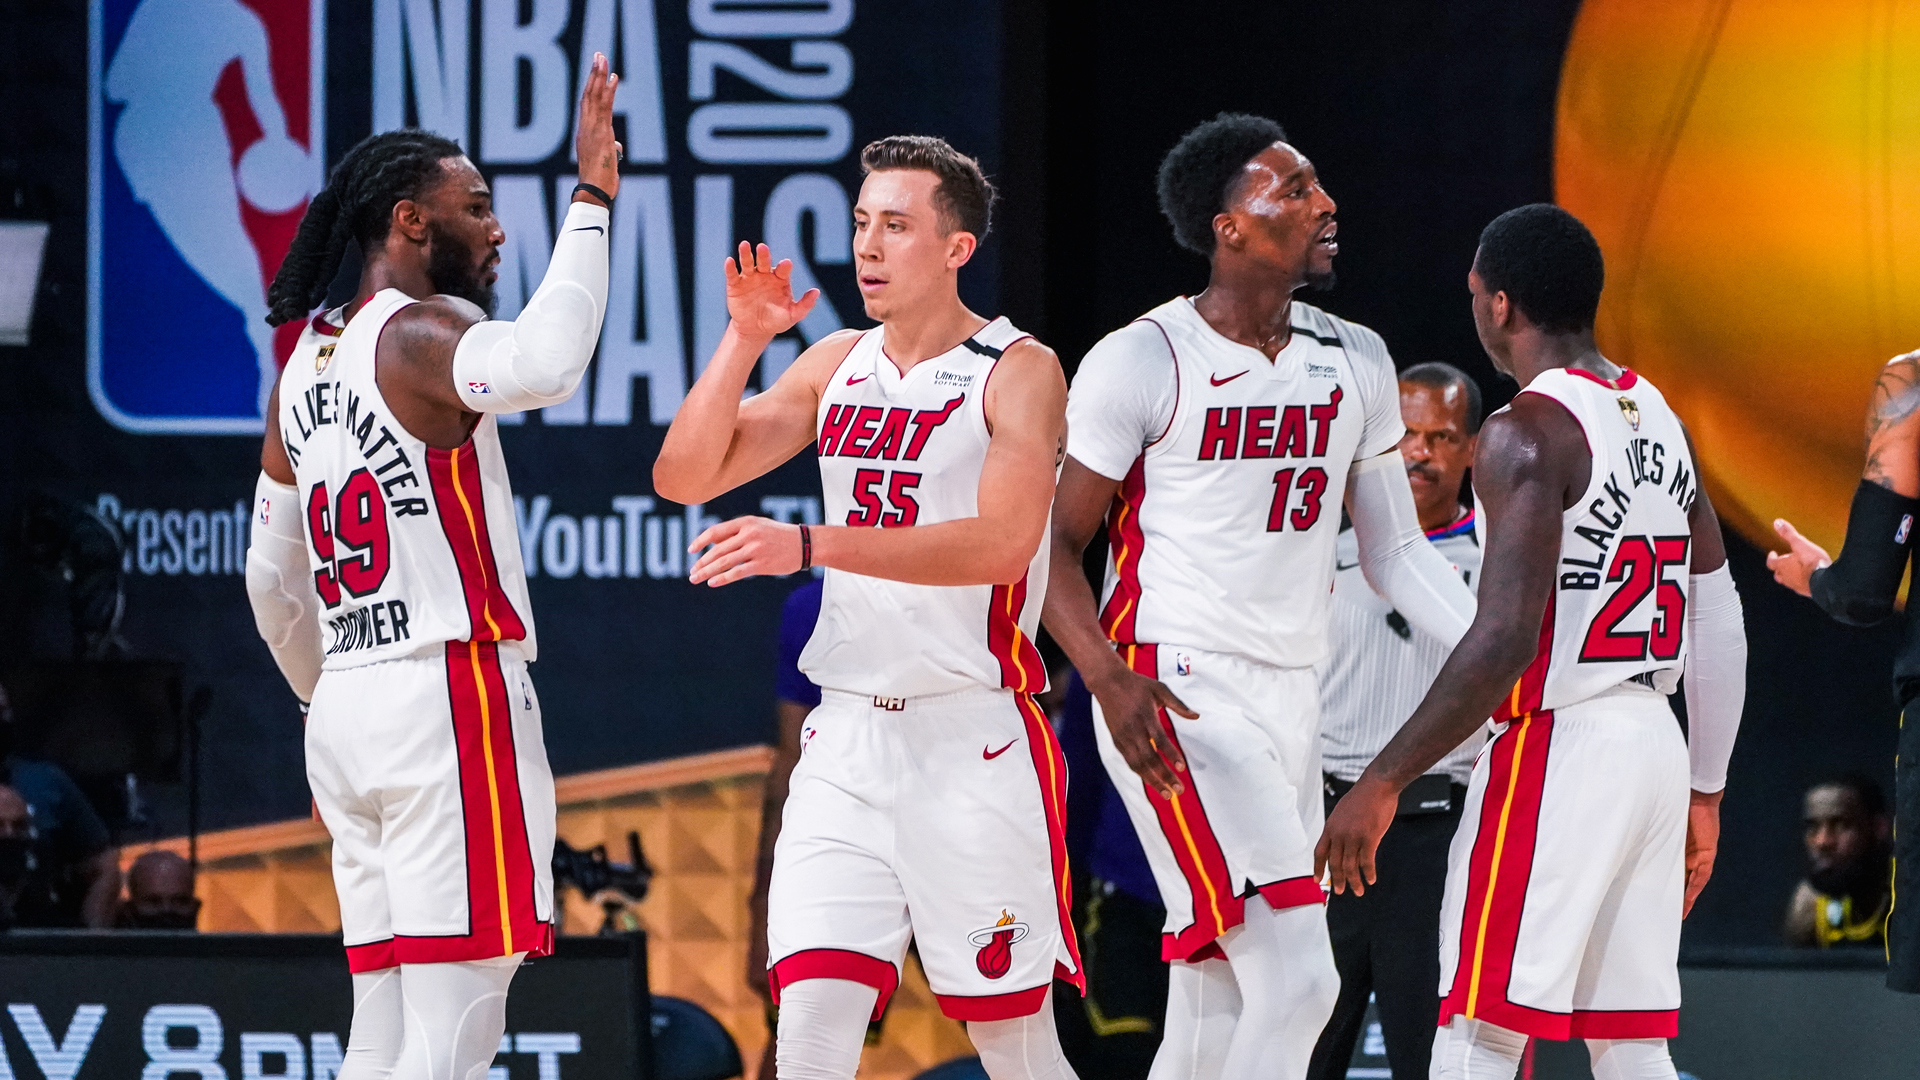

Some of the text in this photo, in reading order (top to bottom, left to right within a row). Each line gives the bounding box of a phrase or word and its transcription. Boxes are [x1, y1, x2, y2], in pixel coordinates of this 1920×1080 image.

[371, 0, 669, 165] NBA
[346, 388, 429, 518] MATTER
[817, 391, 965, 462] HEAT
[1197, 382, 1344, 461] HEAT
[307, 466, 390, 614] 99
[513, 494, 748, 580] YouTub
[845, 467, 922, 528] 55
[1265, 466, 1329, 532] 13
[1560, 471, 1631, 590] BLACK
[326, 599, 410, 655] CROWDER
[1577, 535, 1690, 664] 25
